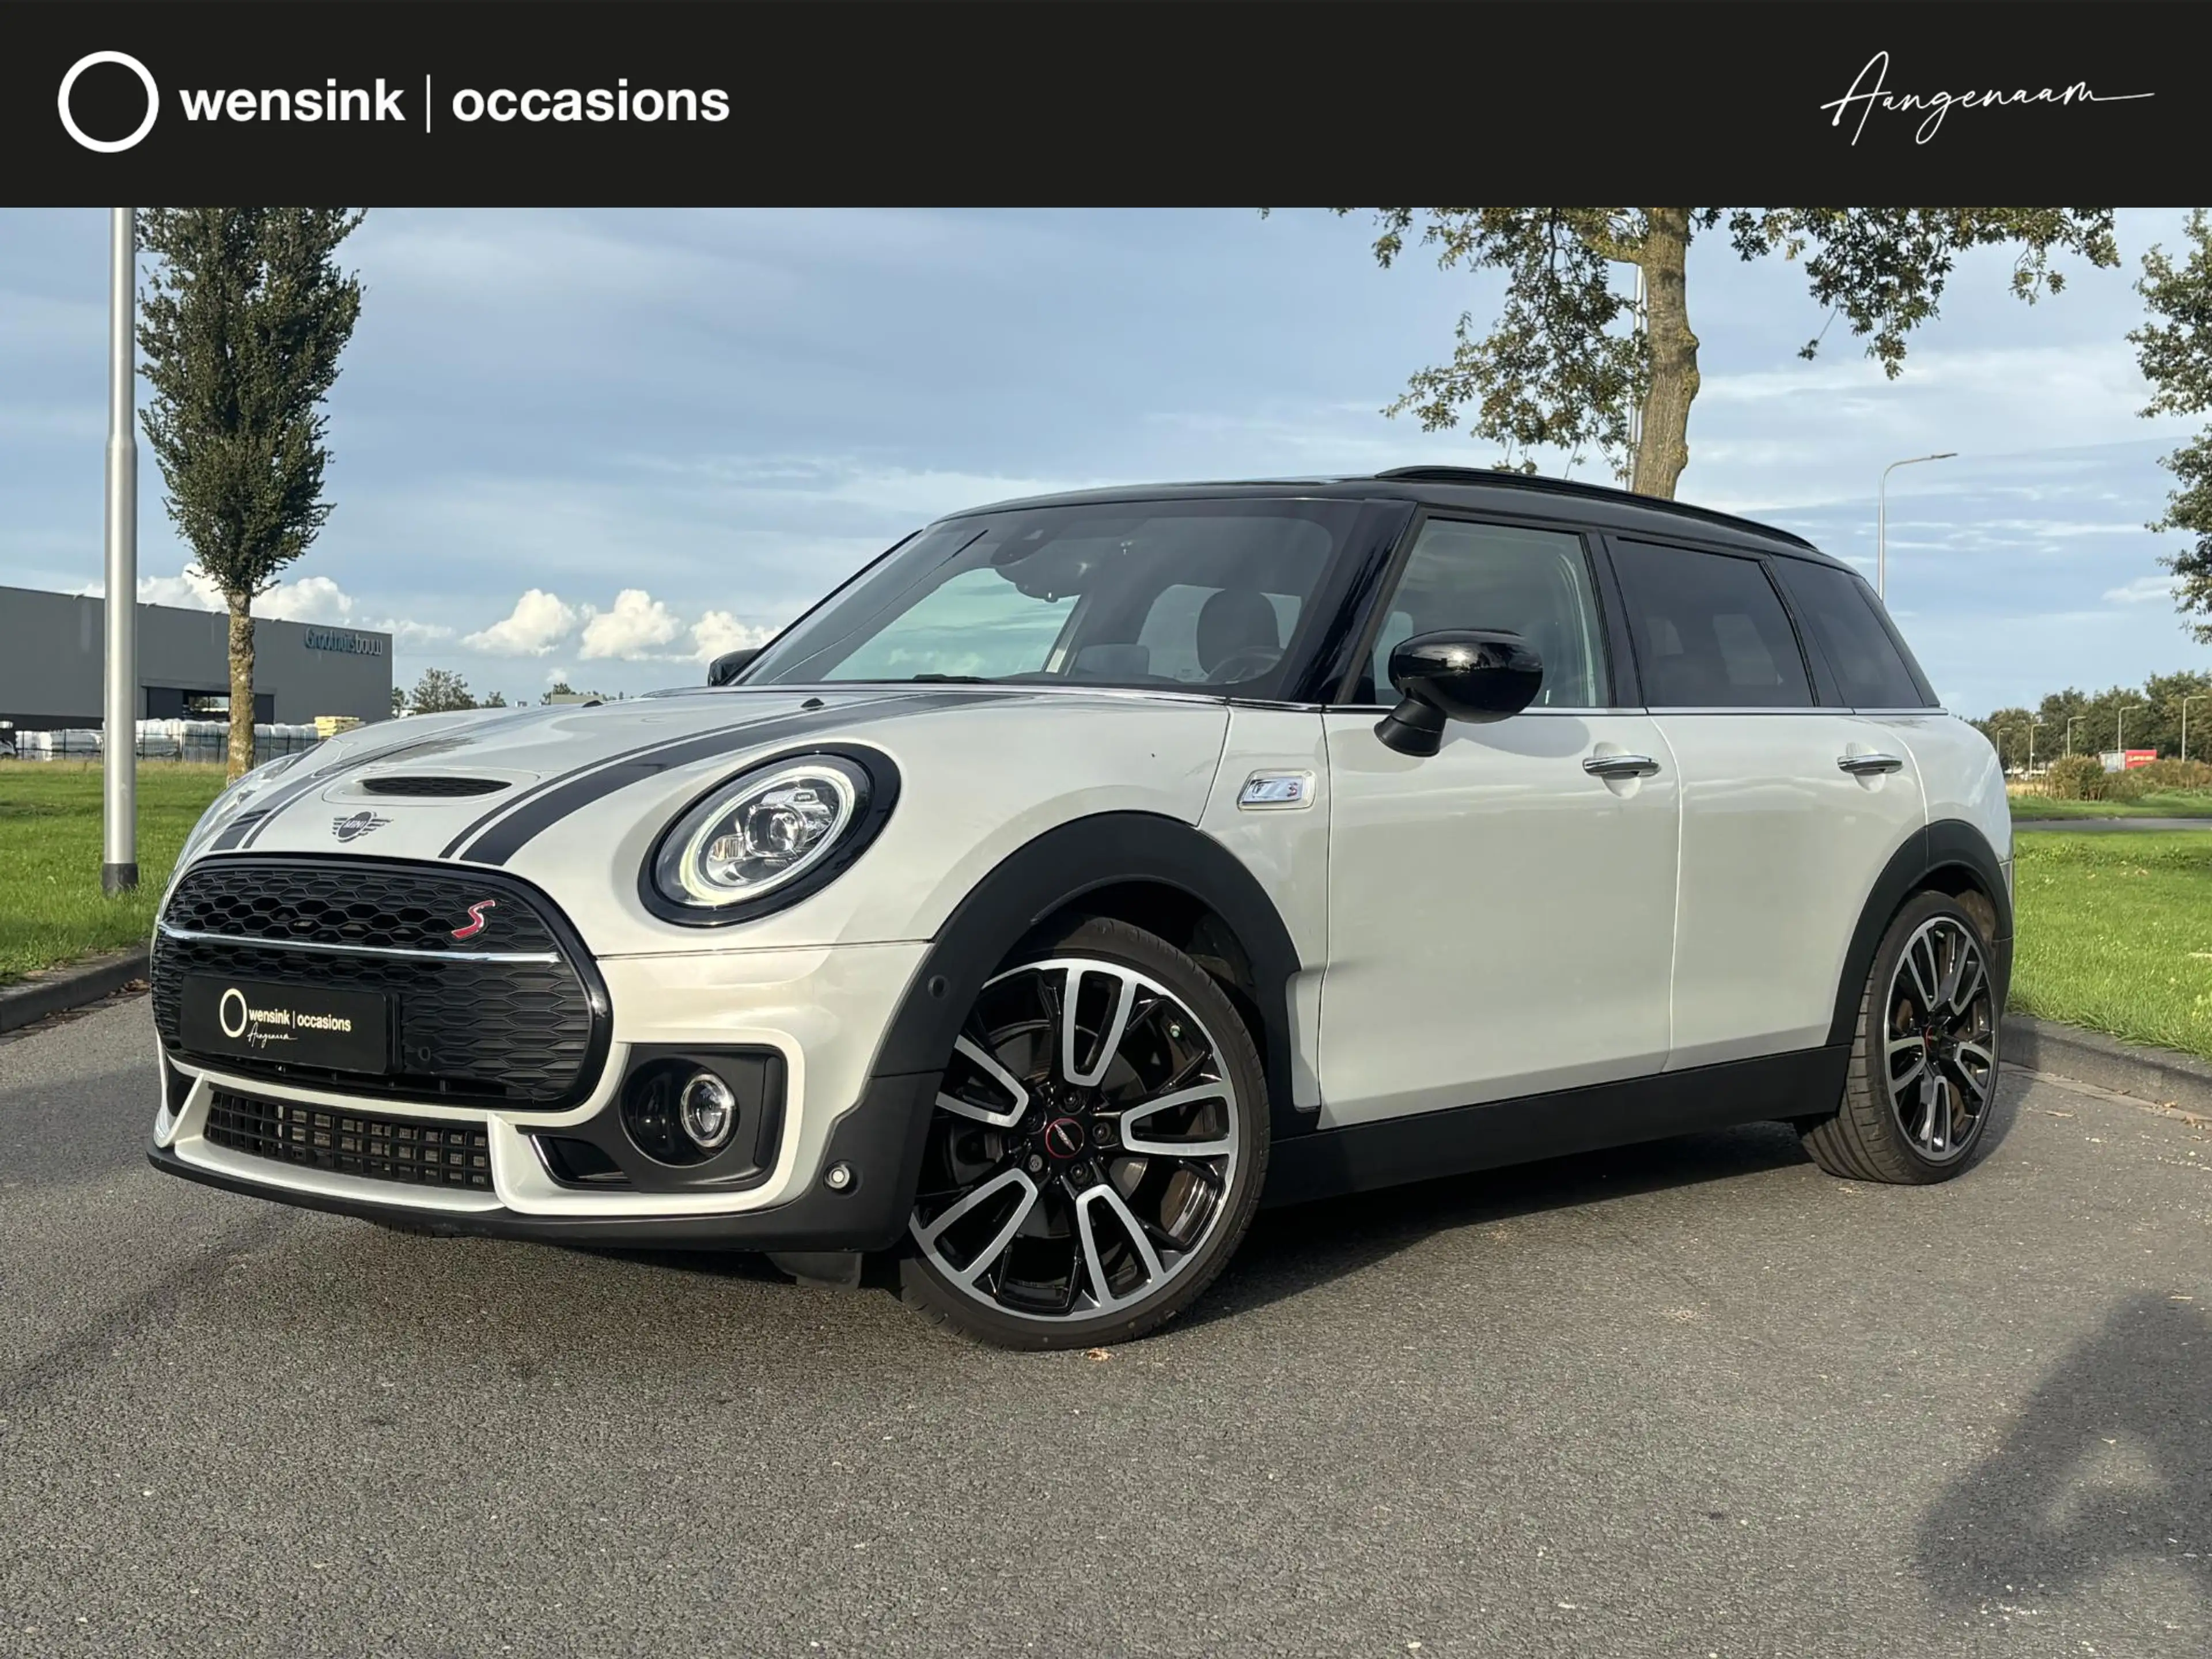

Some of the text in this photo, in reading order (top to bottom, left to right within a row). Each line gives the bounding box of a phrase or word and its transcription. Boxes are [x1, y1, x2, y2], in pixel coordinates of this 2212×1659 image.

[452, 900, 496, 939] S
[248, 1008, 351, 1032] wensink occasions
